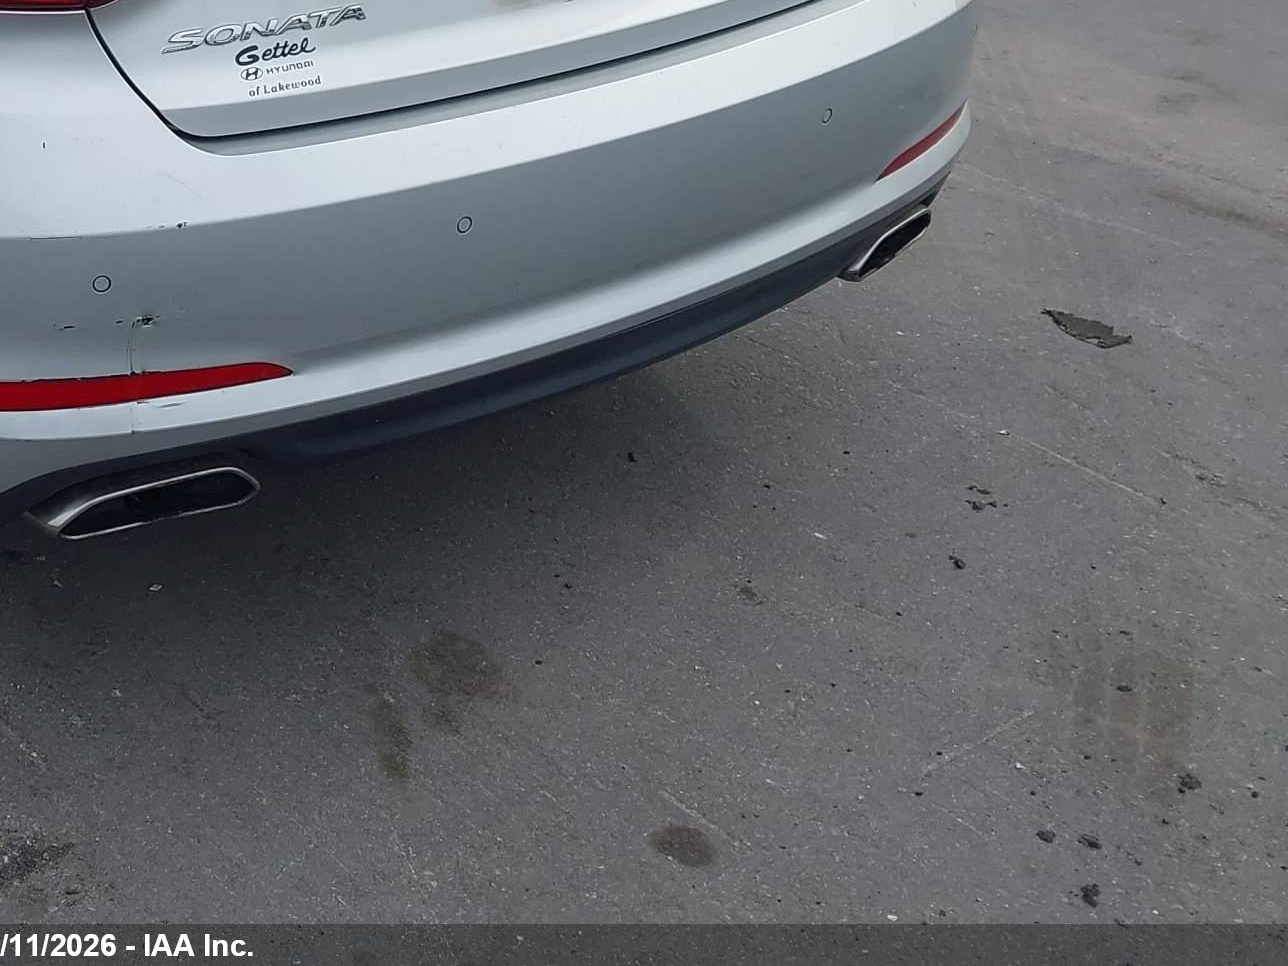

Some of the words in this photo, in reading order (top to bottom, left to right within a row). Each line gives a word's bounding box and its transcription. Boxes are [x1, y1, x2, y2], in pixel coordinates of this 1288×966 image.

[162, 3, 367, 55] SONATA
[235, 37, 316, 66] Gettel
[266, 60, 314, 75] HYUNDAI
[249, 85, 260, 98] of
[263, 75, 322, 94] Lakewood
